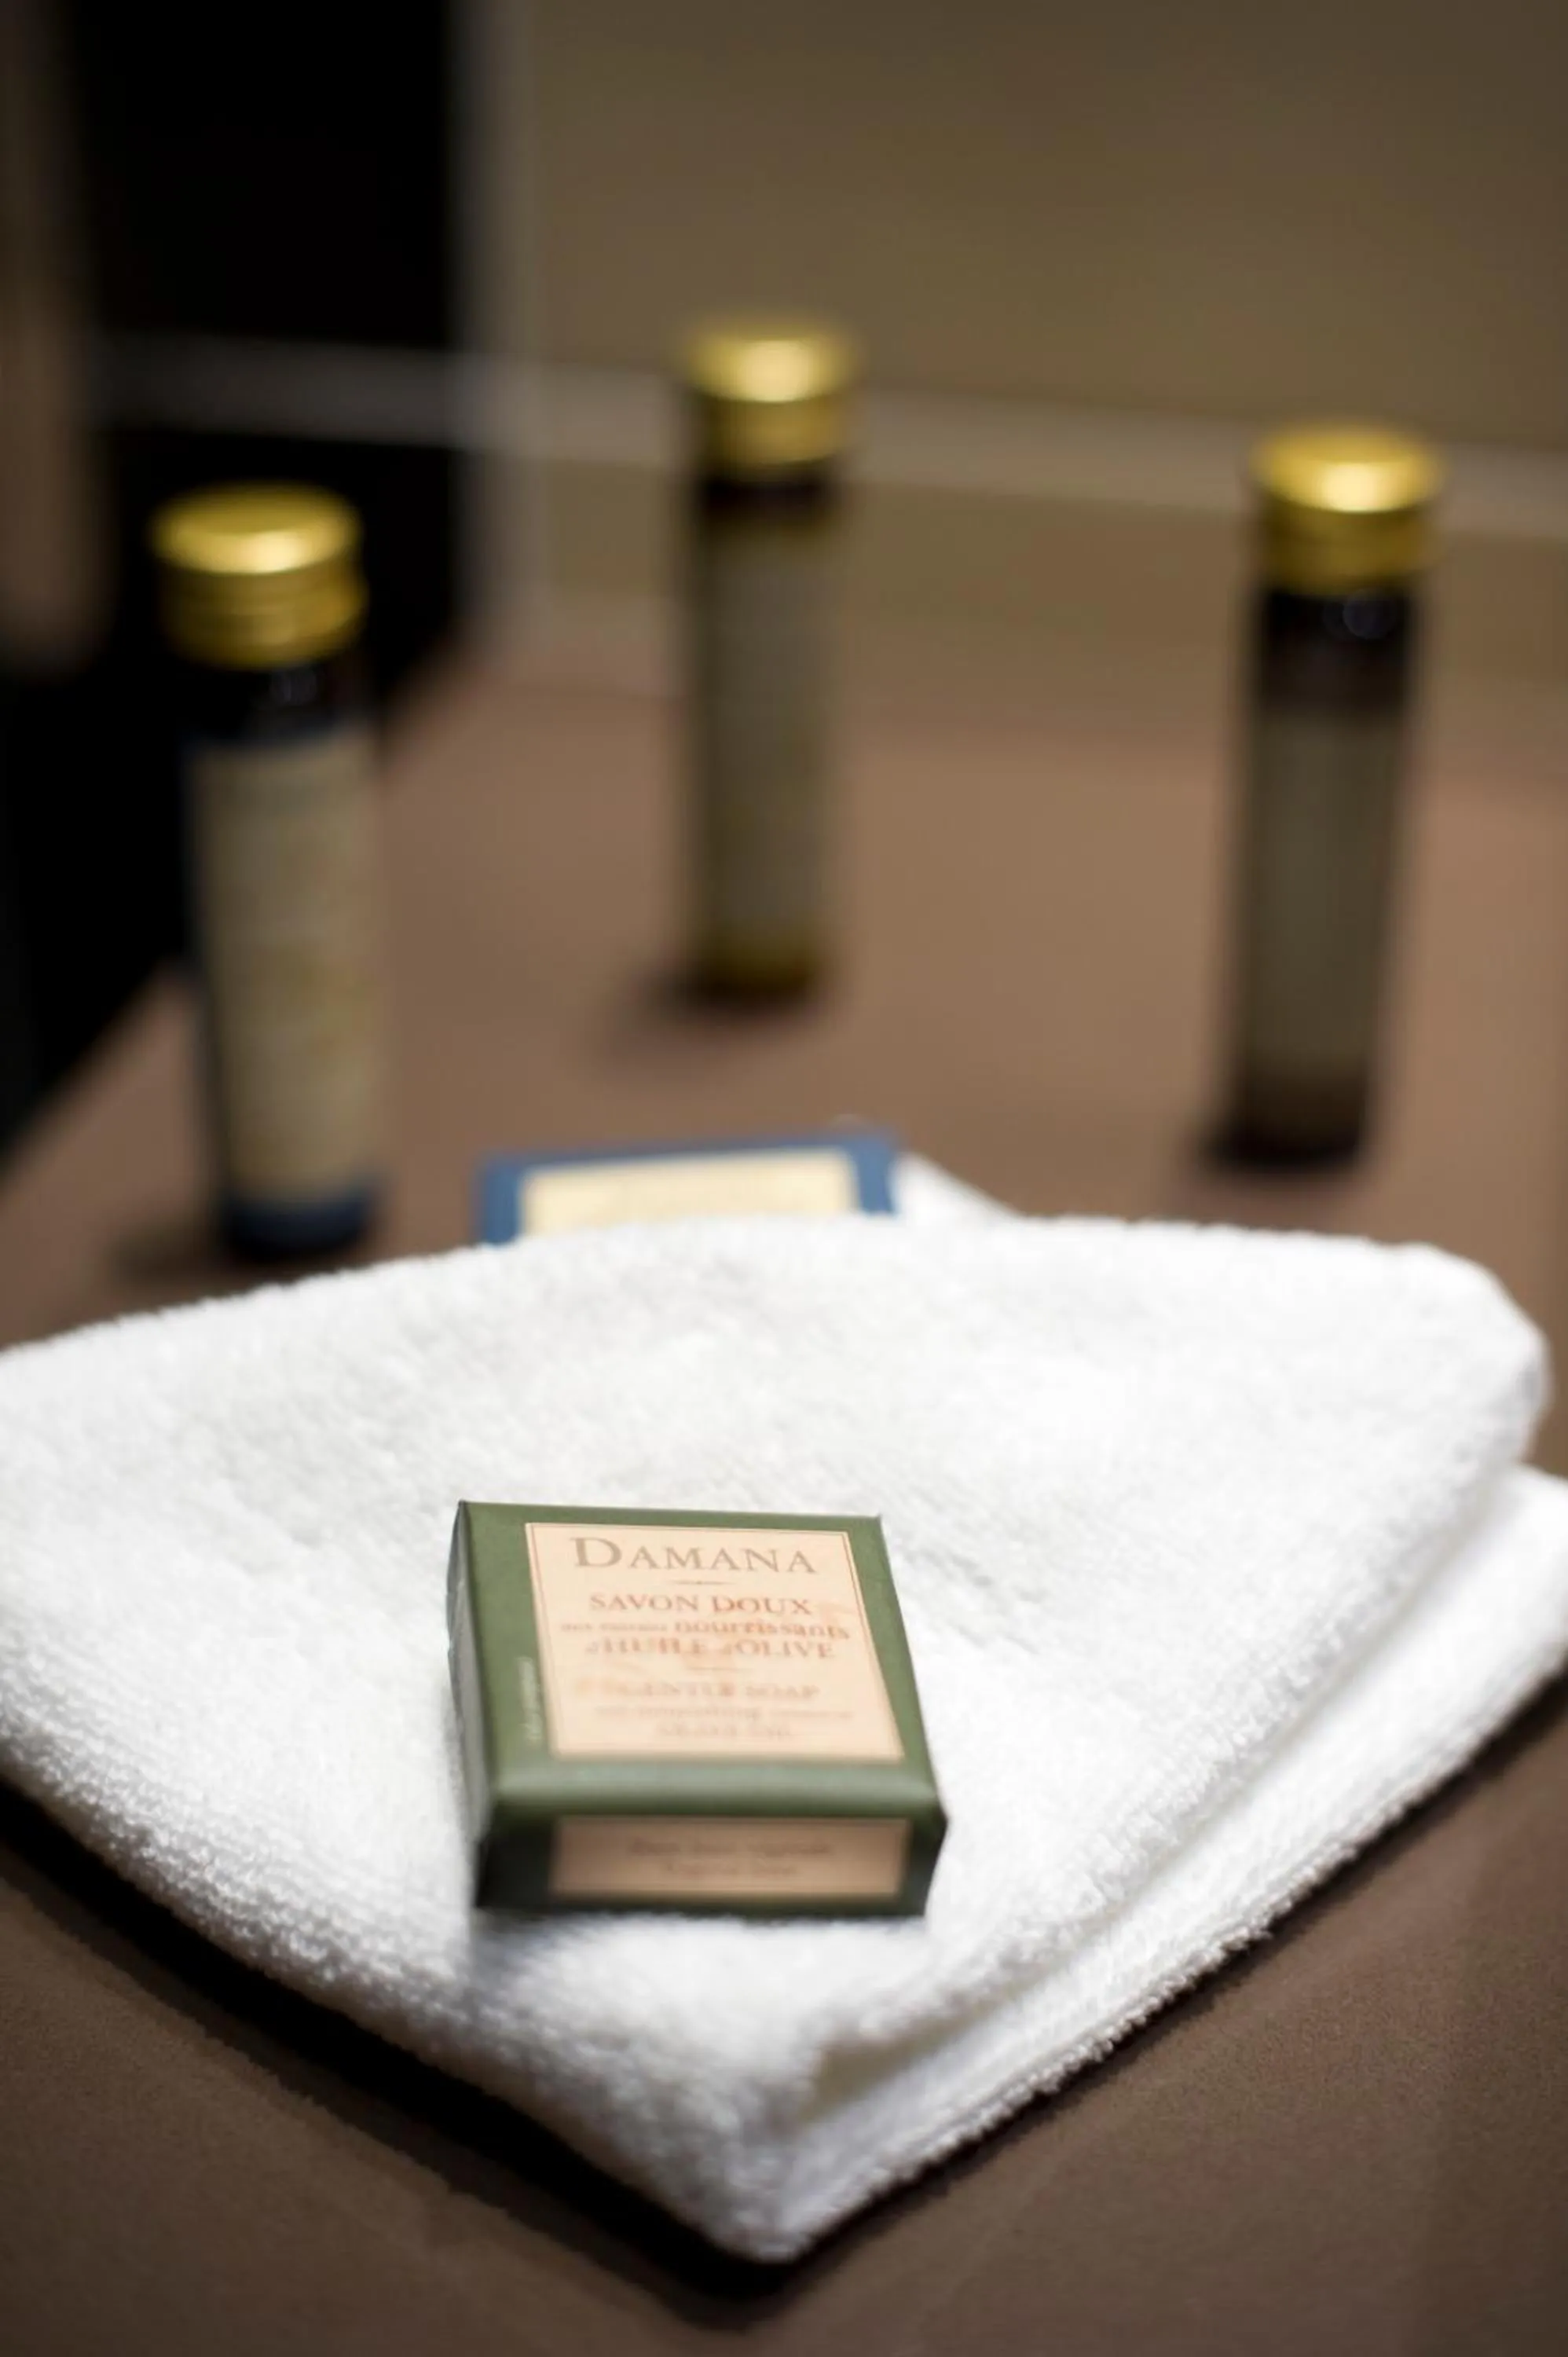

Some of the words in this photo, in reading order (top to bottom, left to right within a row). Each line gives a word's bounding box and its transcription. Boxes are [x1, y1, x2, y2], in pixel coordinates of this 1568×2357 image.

[570, 1537, 818, 1574] DAMANA
[589, 1593, 699, 1612] SAVON
[712, 1595, 812, 1615] DOUX
